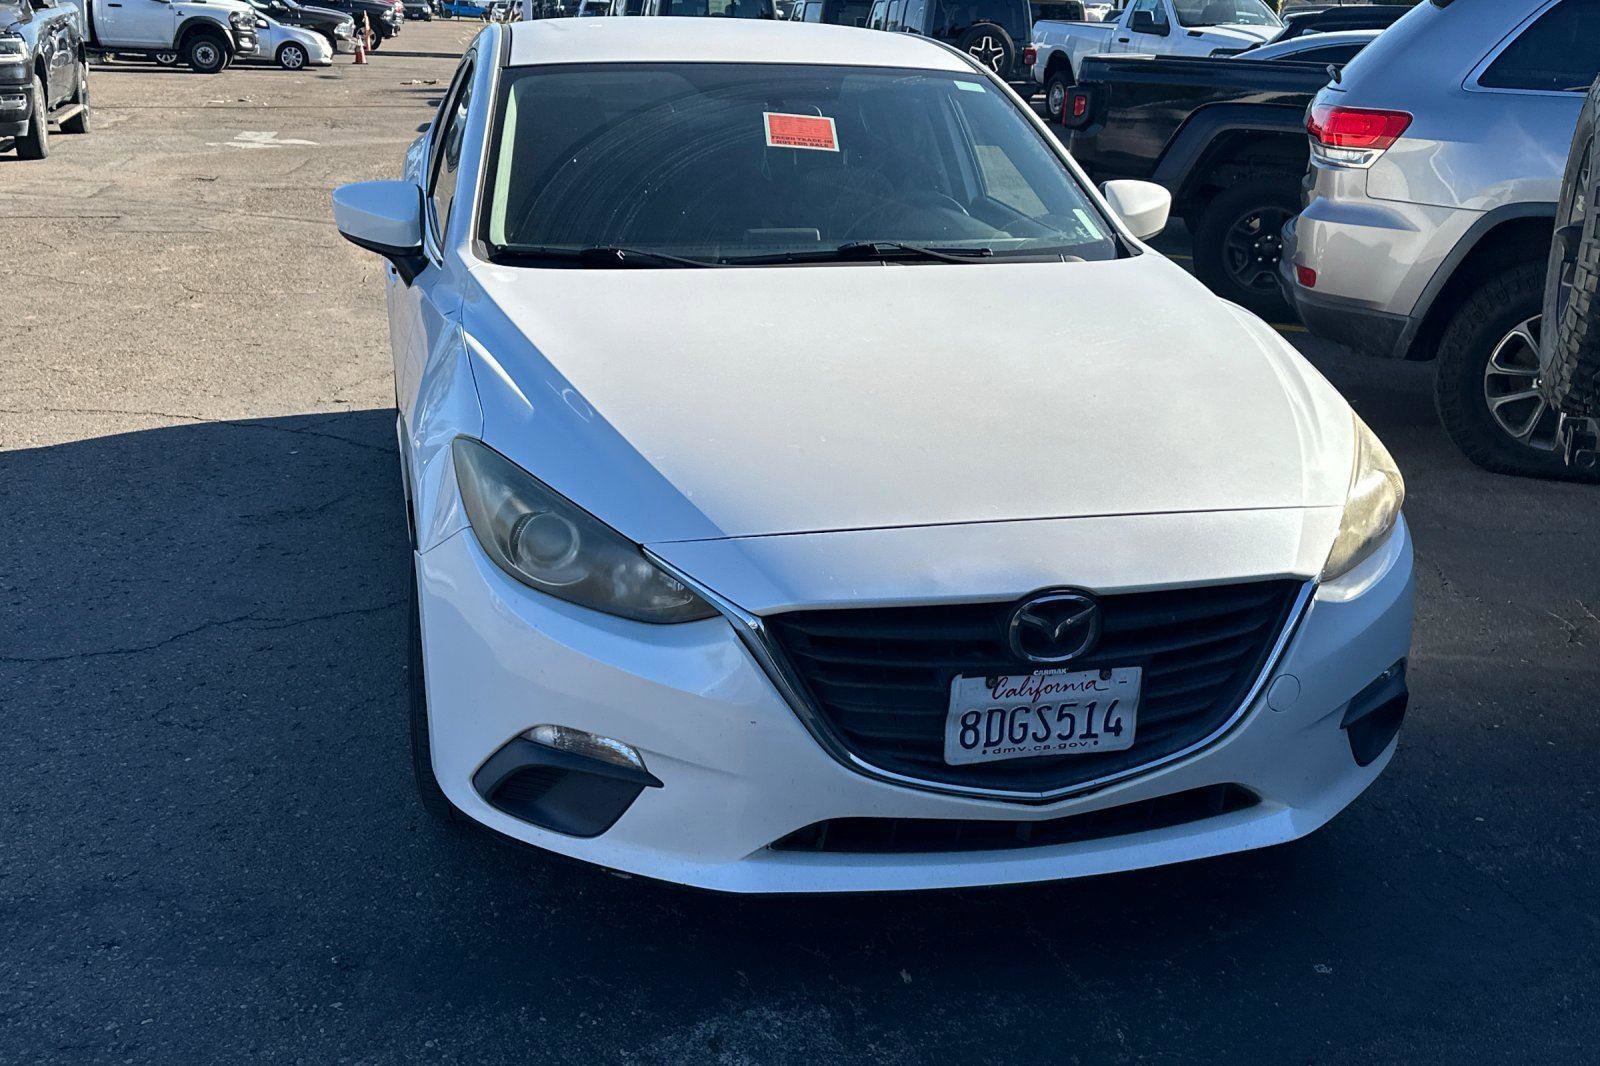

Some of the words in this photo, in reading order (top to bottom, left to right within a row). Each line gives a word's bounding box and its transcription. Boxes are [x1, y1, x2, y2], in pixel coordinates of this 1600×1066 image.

[991, 676, 1109, 703] California
[959, 699, 1123, 750] 8DGS514
[992, 741, 1088, 755] dmv.ca.gov
